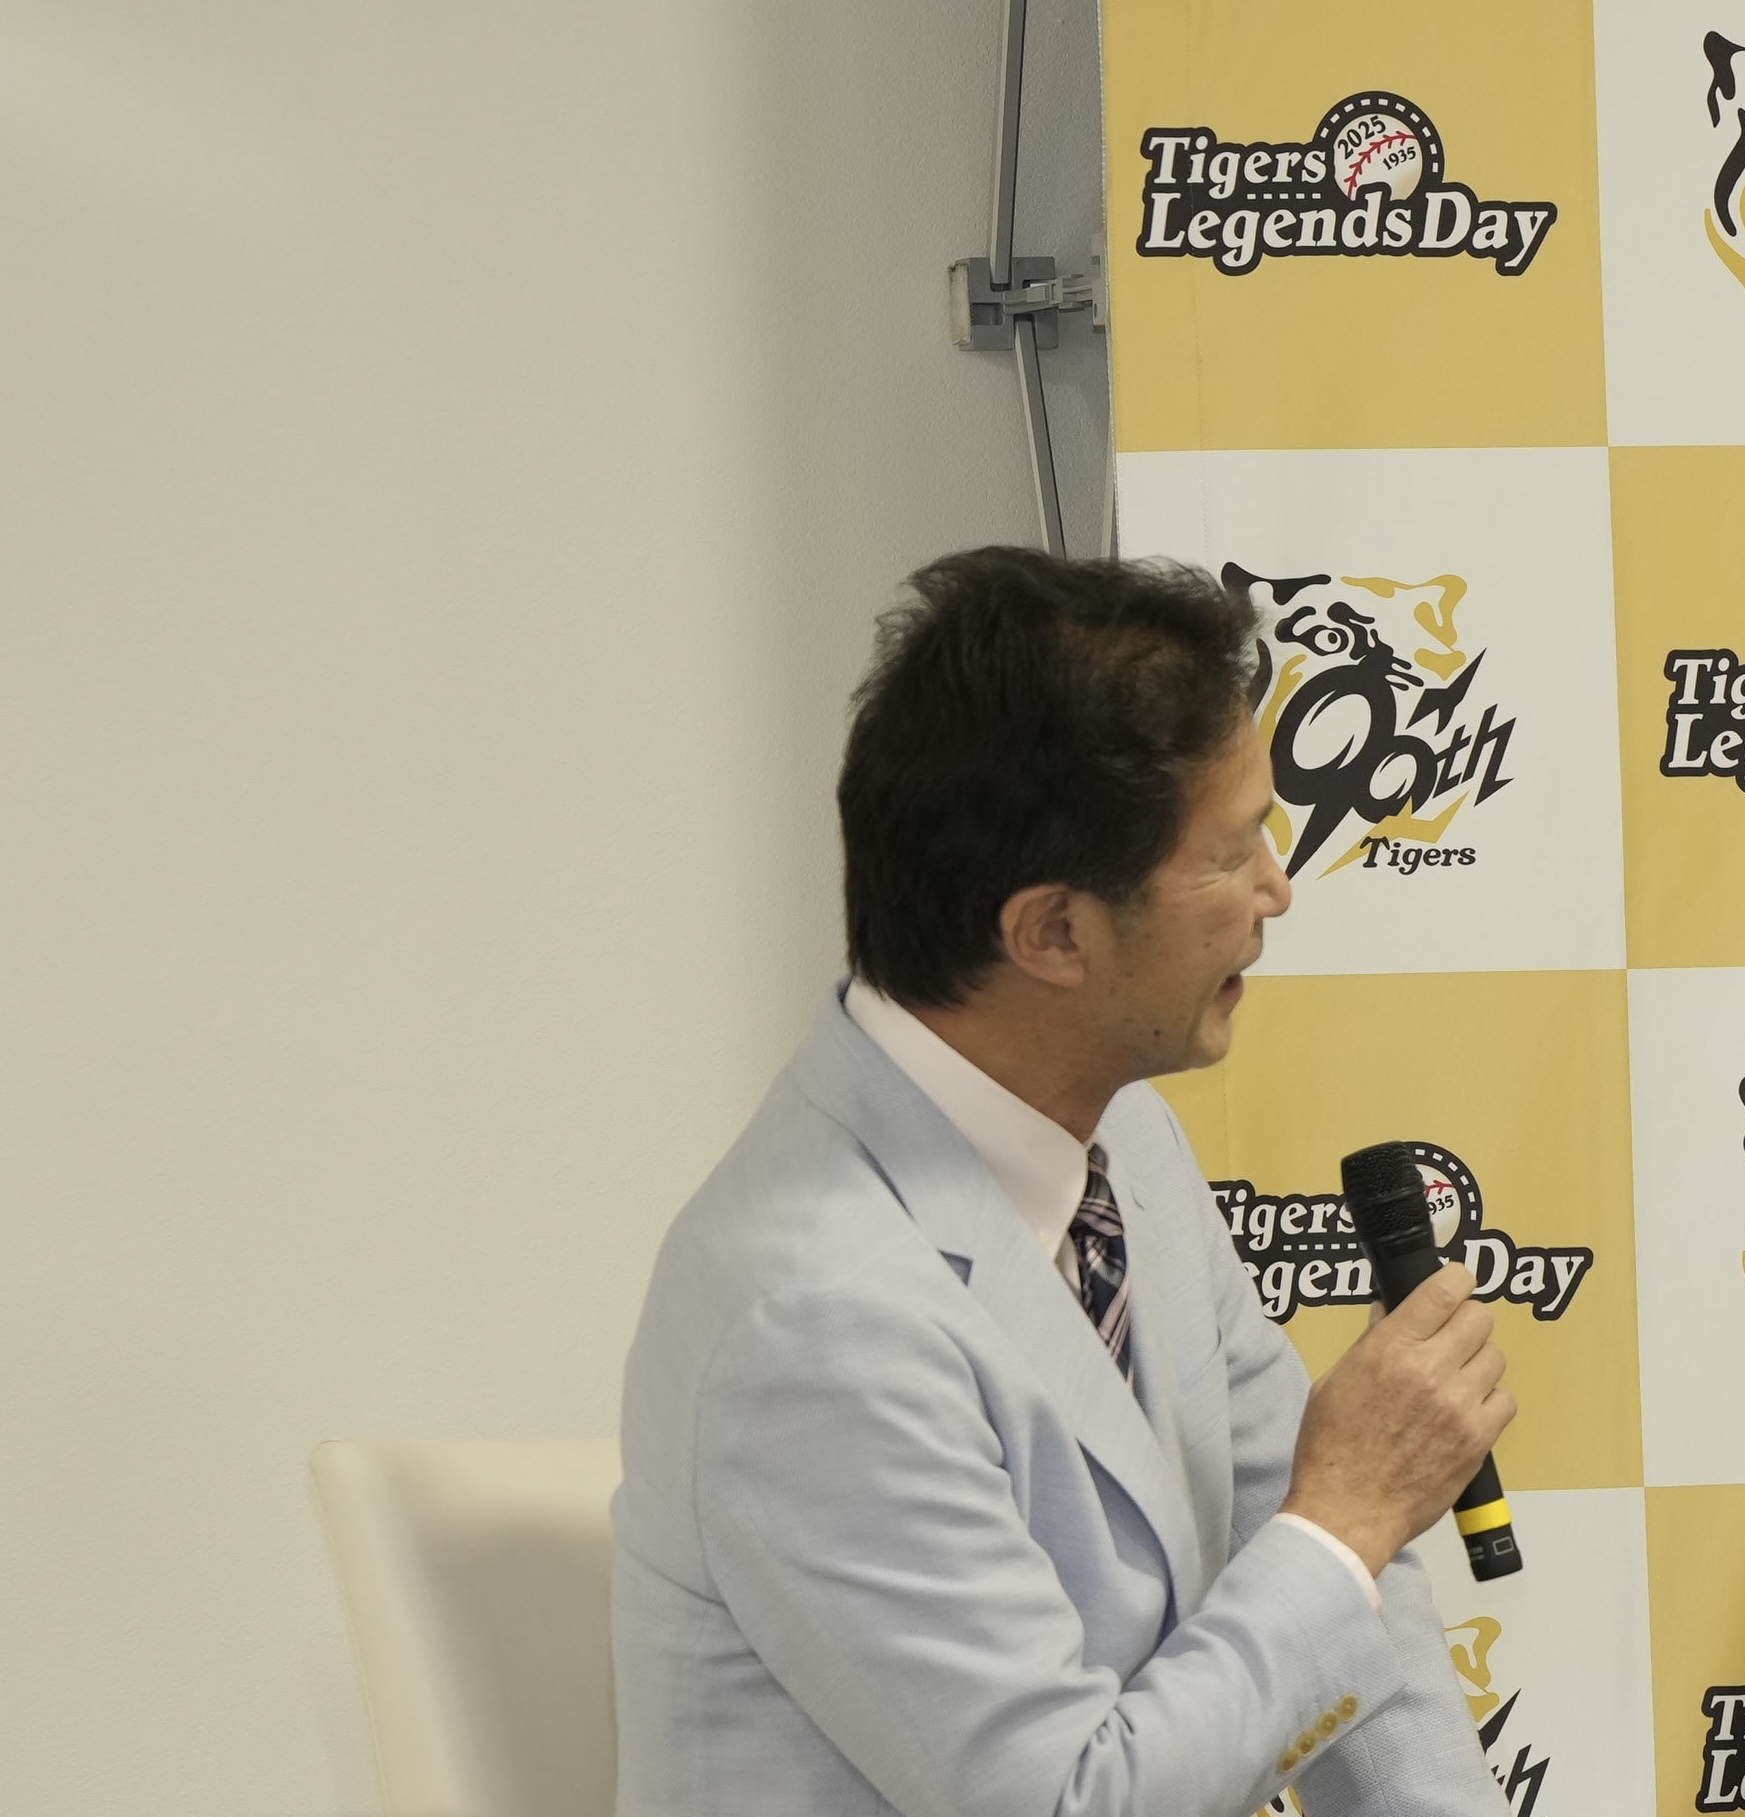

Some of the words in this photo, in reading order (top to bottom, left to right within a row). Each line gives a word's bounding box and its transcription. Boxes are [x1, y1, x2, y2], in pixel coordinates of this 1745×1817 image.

[1337, 115, 1387, 160] 2025
[1148, 136, 1327, 199] Tigers
[1381, 145, 1418, 171] 1935
[1359, 835, 1477, 875] Tigers
[1427, 1195, 1455, 1217] 935
